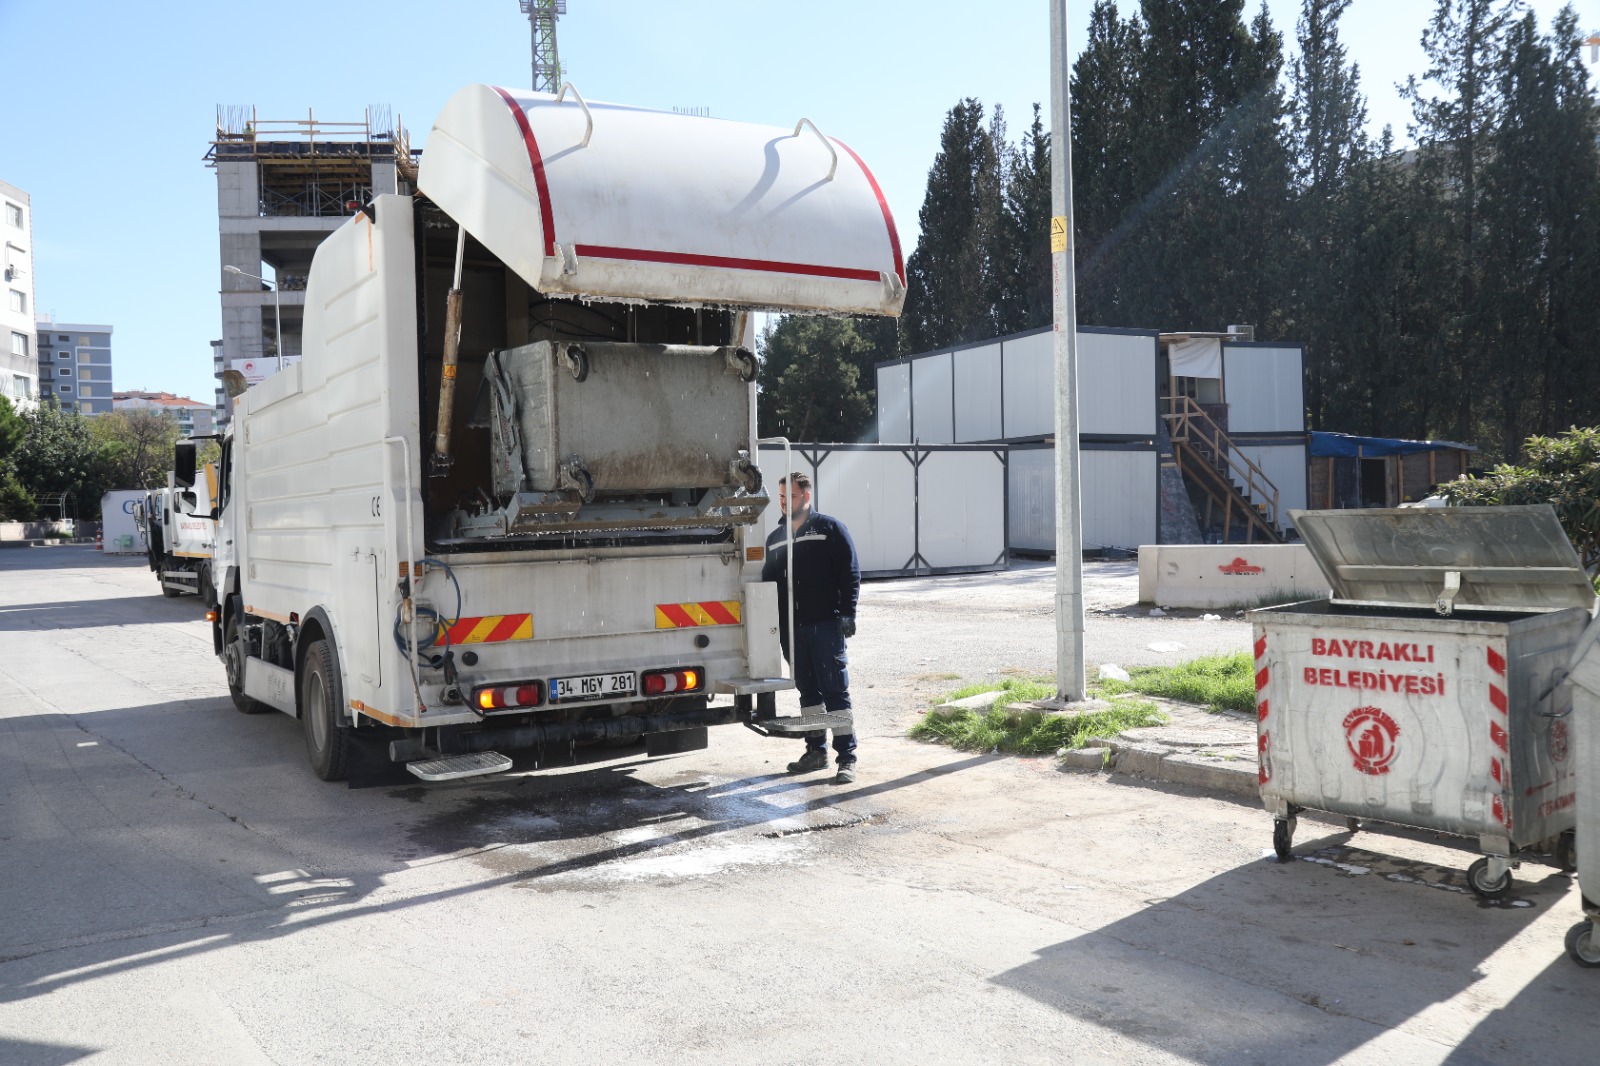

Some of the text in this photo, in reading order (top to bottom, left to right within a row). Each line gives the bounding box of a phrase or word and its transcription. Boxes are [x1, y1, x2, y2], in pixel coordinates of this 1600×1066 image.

[1311, 638, 1435, 663] BAYRAKLI
[558, 680, 573, 696] 34
[581, 677, 603, 694] MGY
[611, 675, 632, 691] 281
[1303, 667, 1446, 696] BELEDİYESİ
